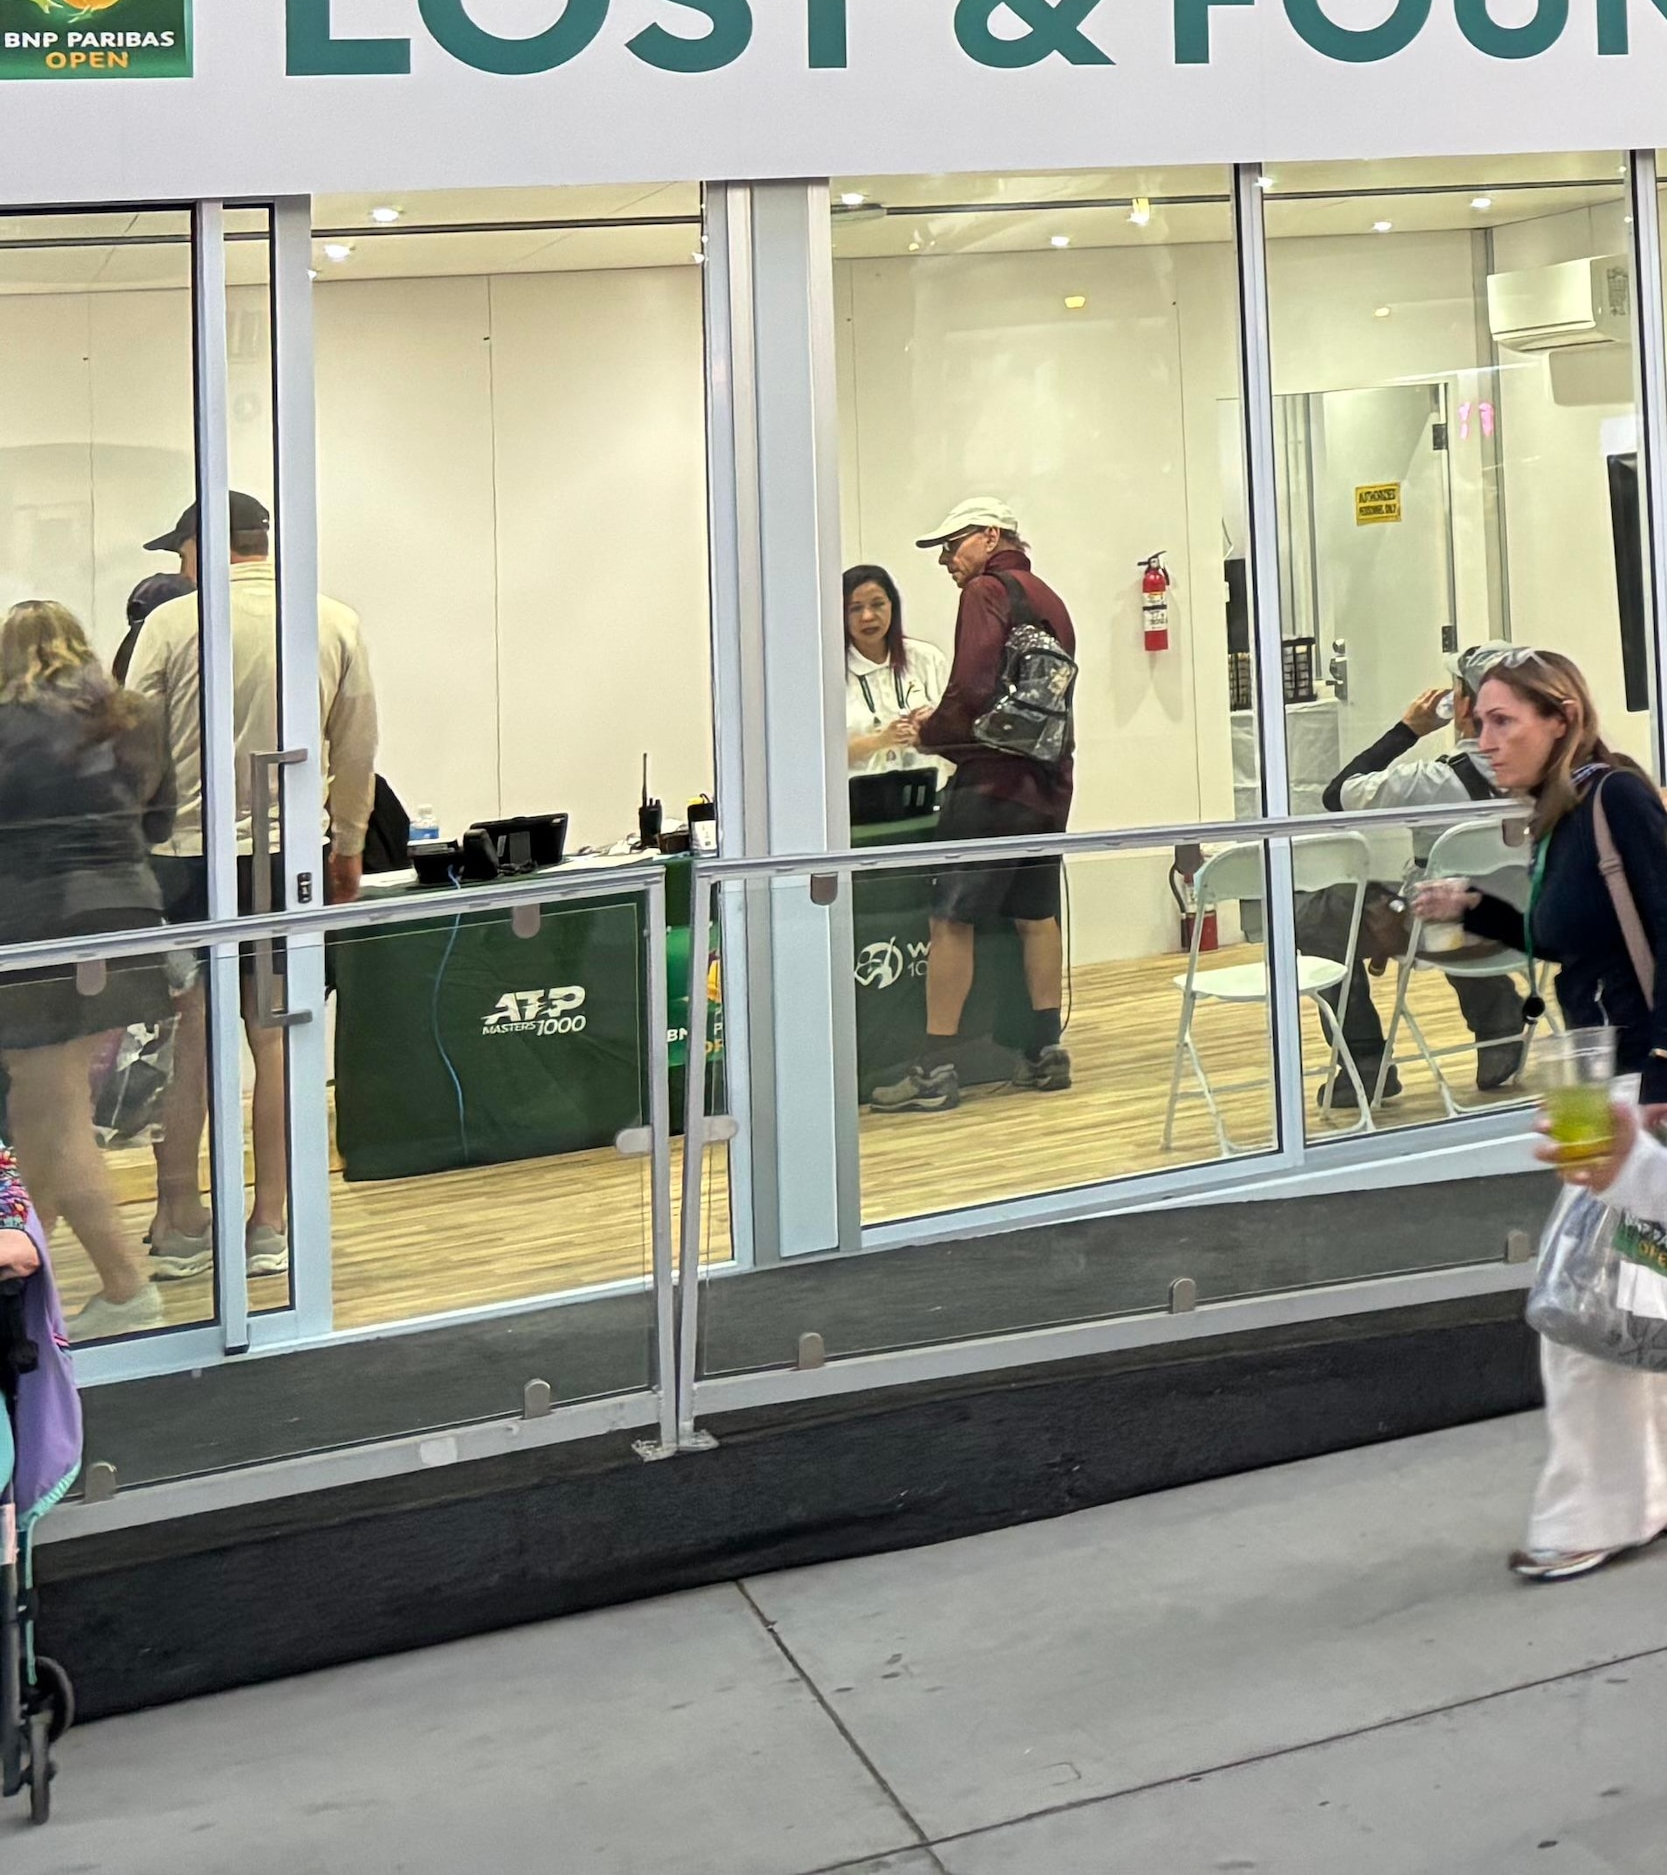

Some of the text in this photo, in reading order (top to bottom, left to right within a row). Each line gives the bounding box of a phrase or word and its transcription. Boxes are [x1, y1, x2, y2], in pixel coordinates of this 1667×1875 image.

[4, 31, 175, 48] BNP PARIBAS
[45, 51, 129, 70] OPEN
[481, 985, 586, 1025] ATP
[482, 1014, 587, 1037] MASTERS 1000
